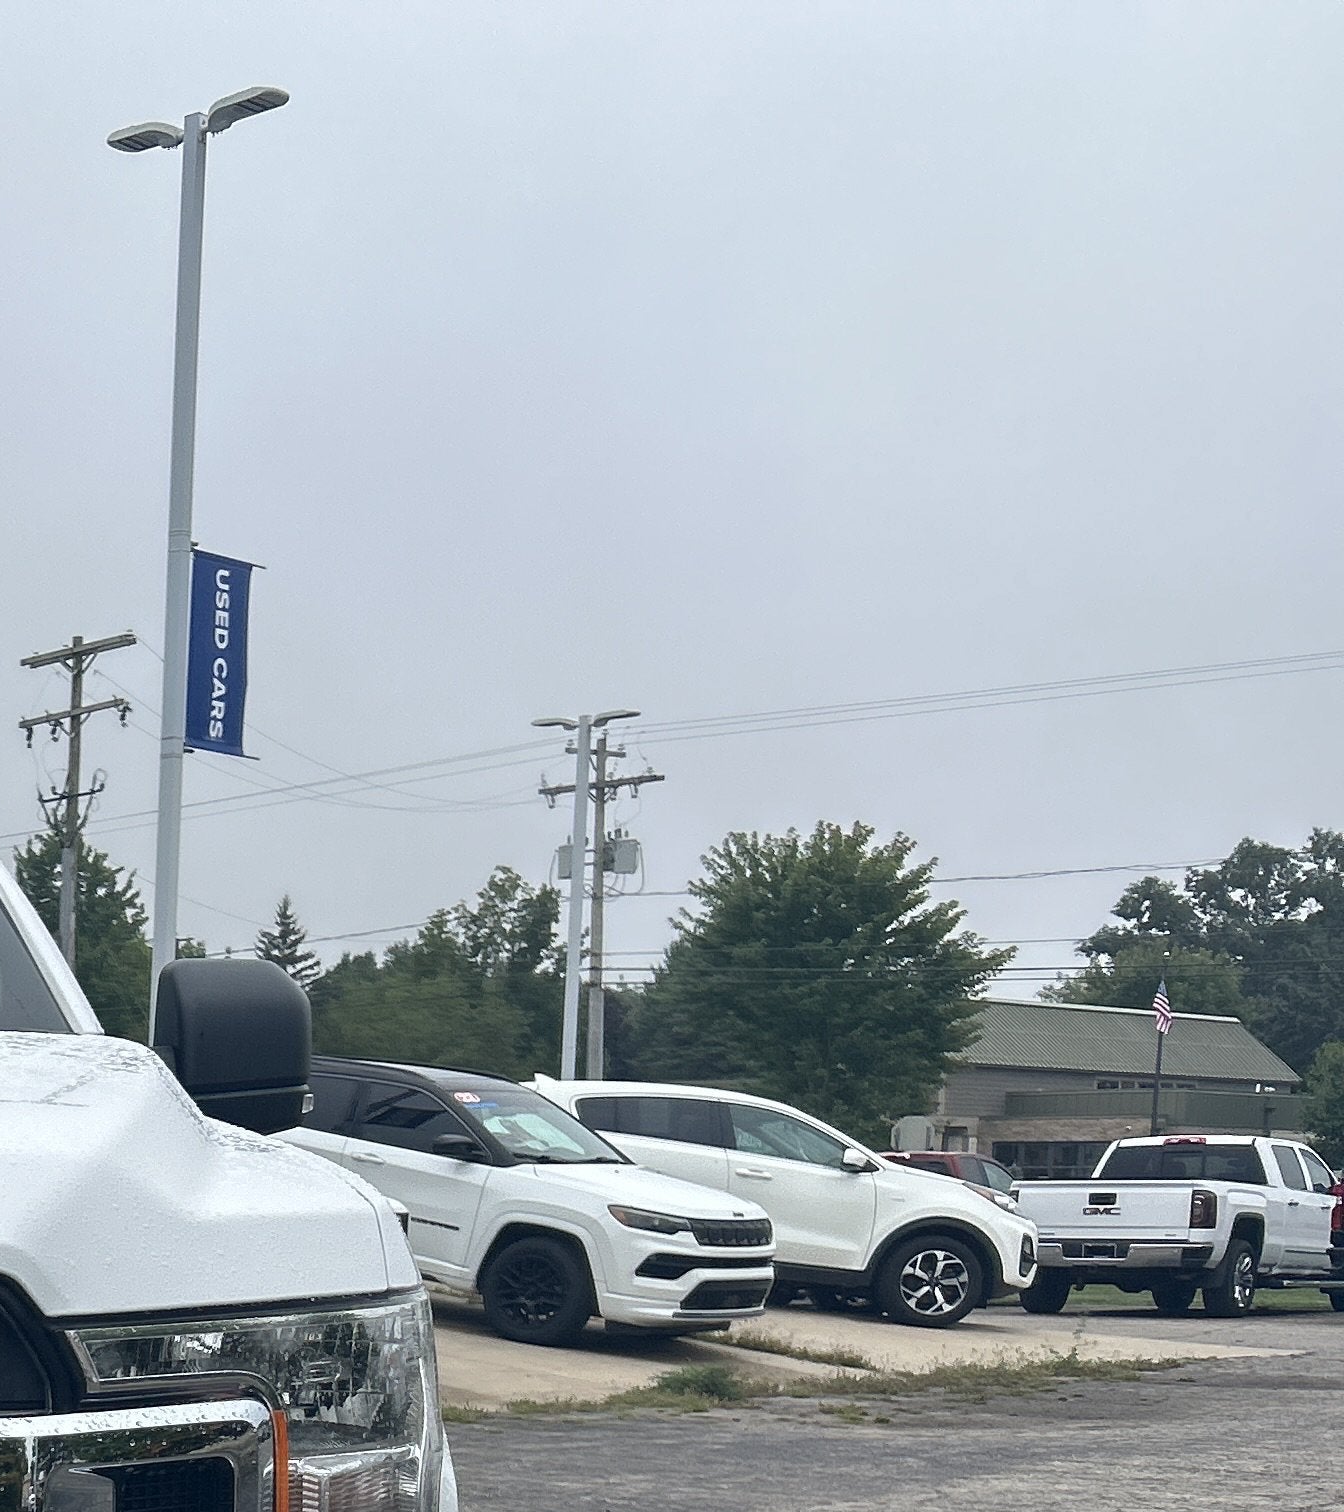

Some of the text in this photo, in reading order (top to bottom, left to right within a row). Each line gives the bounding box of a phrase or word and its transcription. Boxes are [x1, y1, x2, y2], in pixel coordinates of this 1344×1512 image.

[208, 568, 230, 739] USED CARS
[1082, 1207, 1121, 1216] GMC
